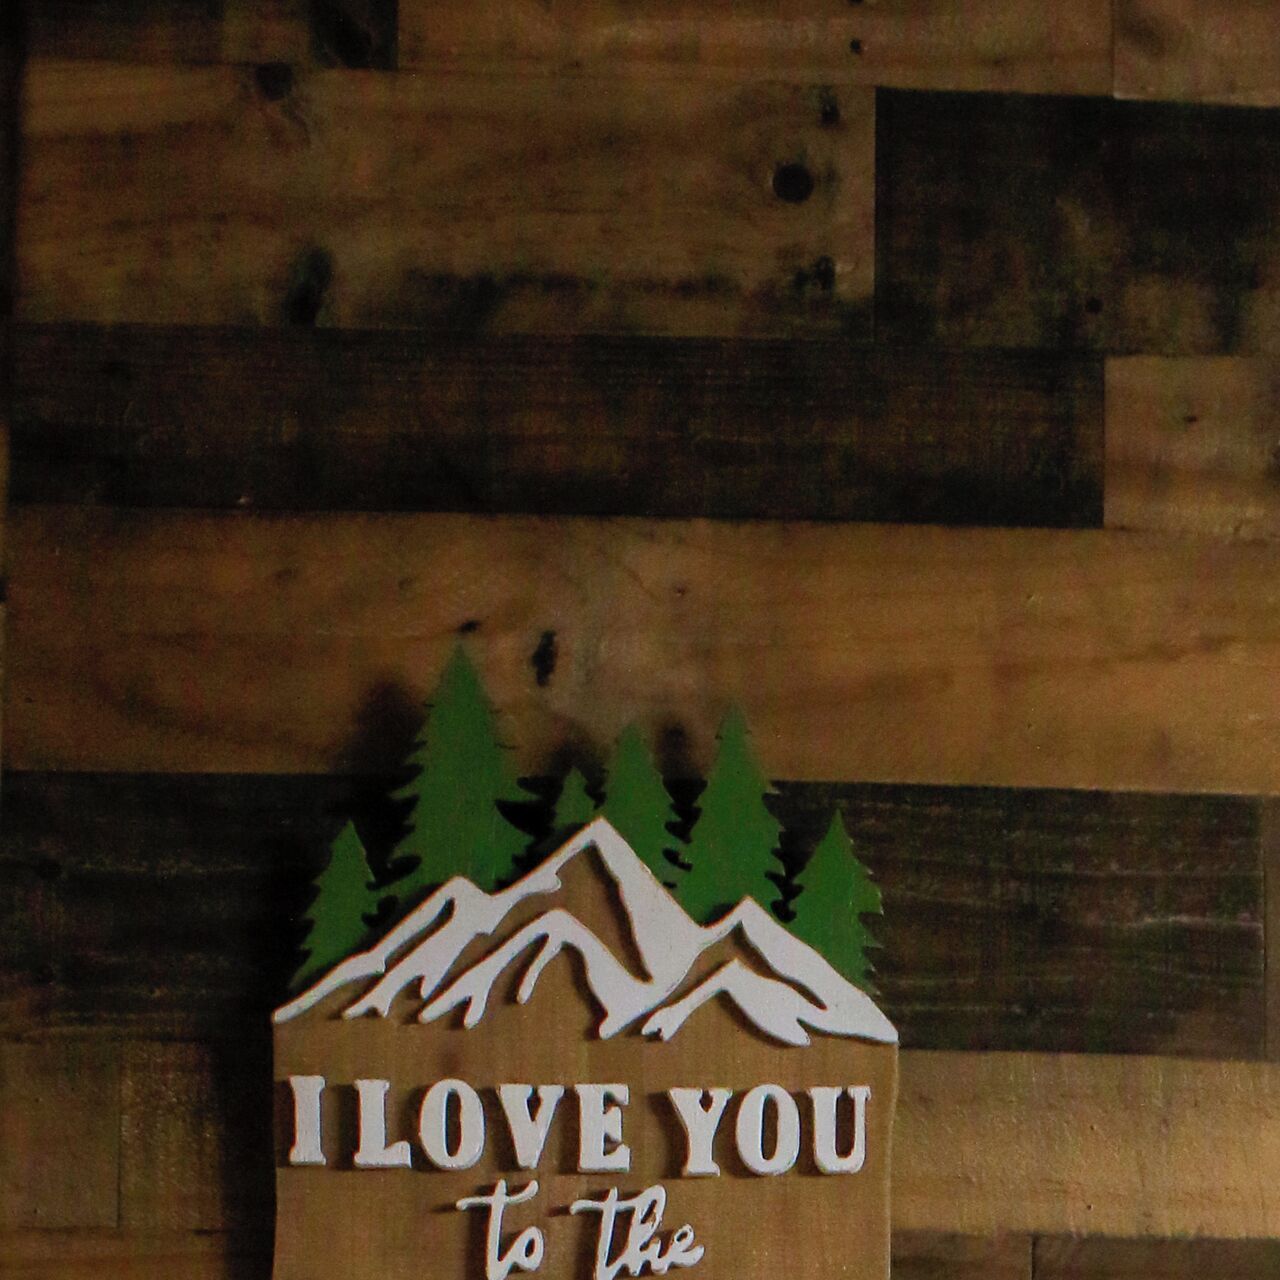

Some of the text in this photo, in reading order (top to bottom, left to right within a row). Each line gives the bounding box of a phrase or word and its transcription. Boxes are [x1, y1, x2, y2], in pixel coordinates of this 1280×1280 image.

[289, 1075, 870, 1177] I LOVE YOU
